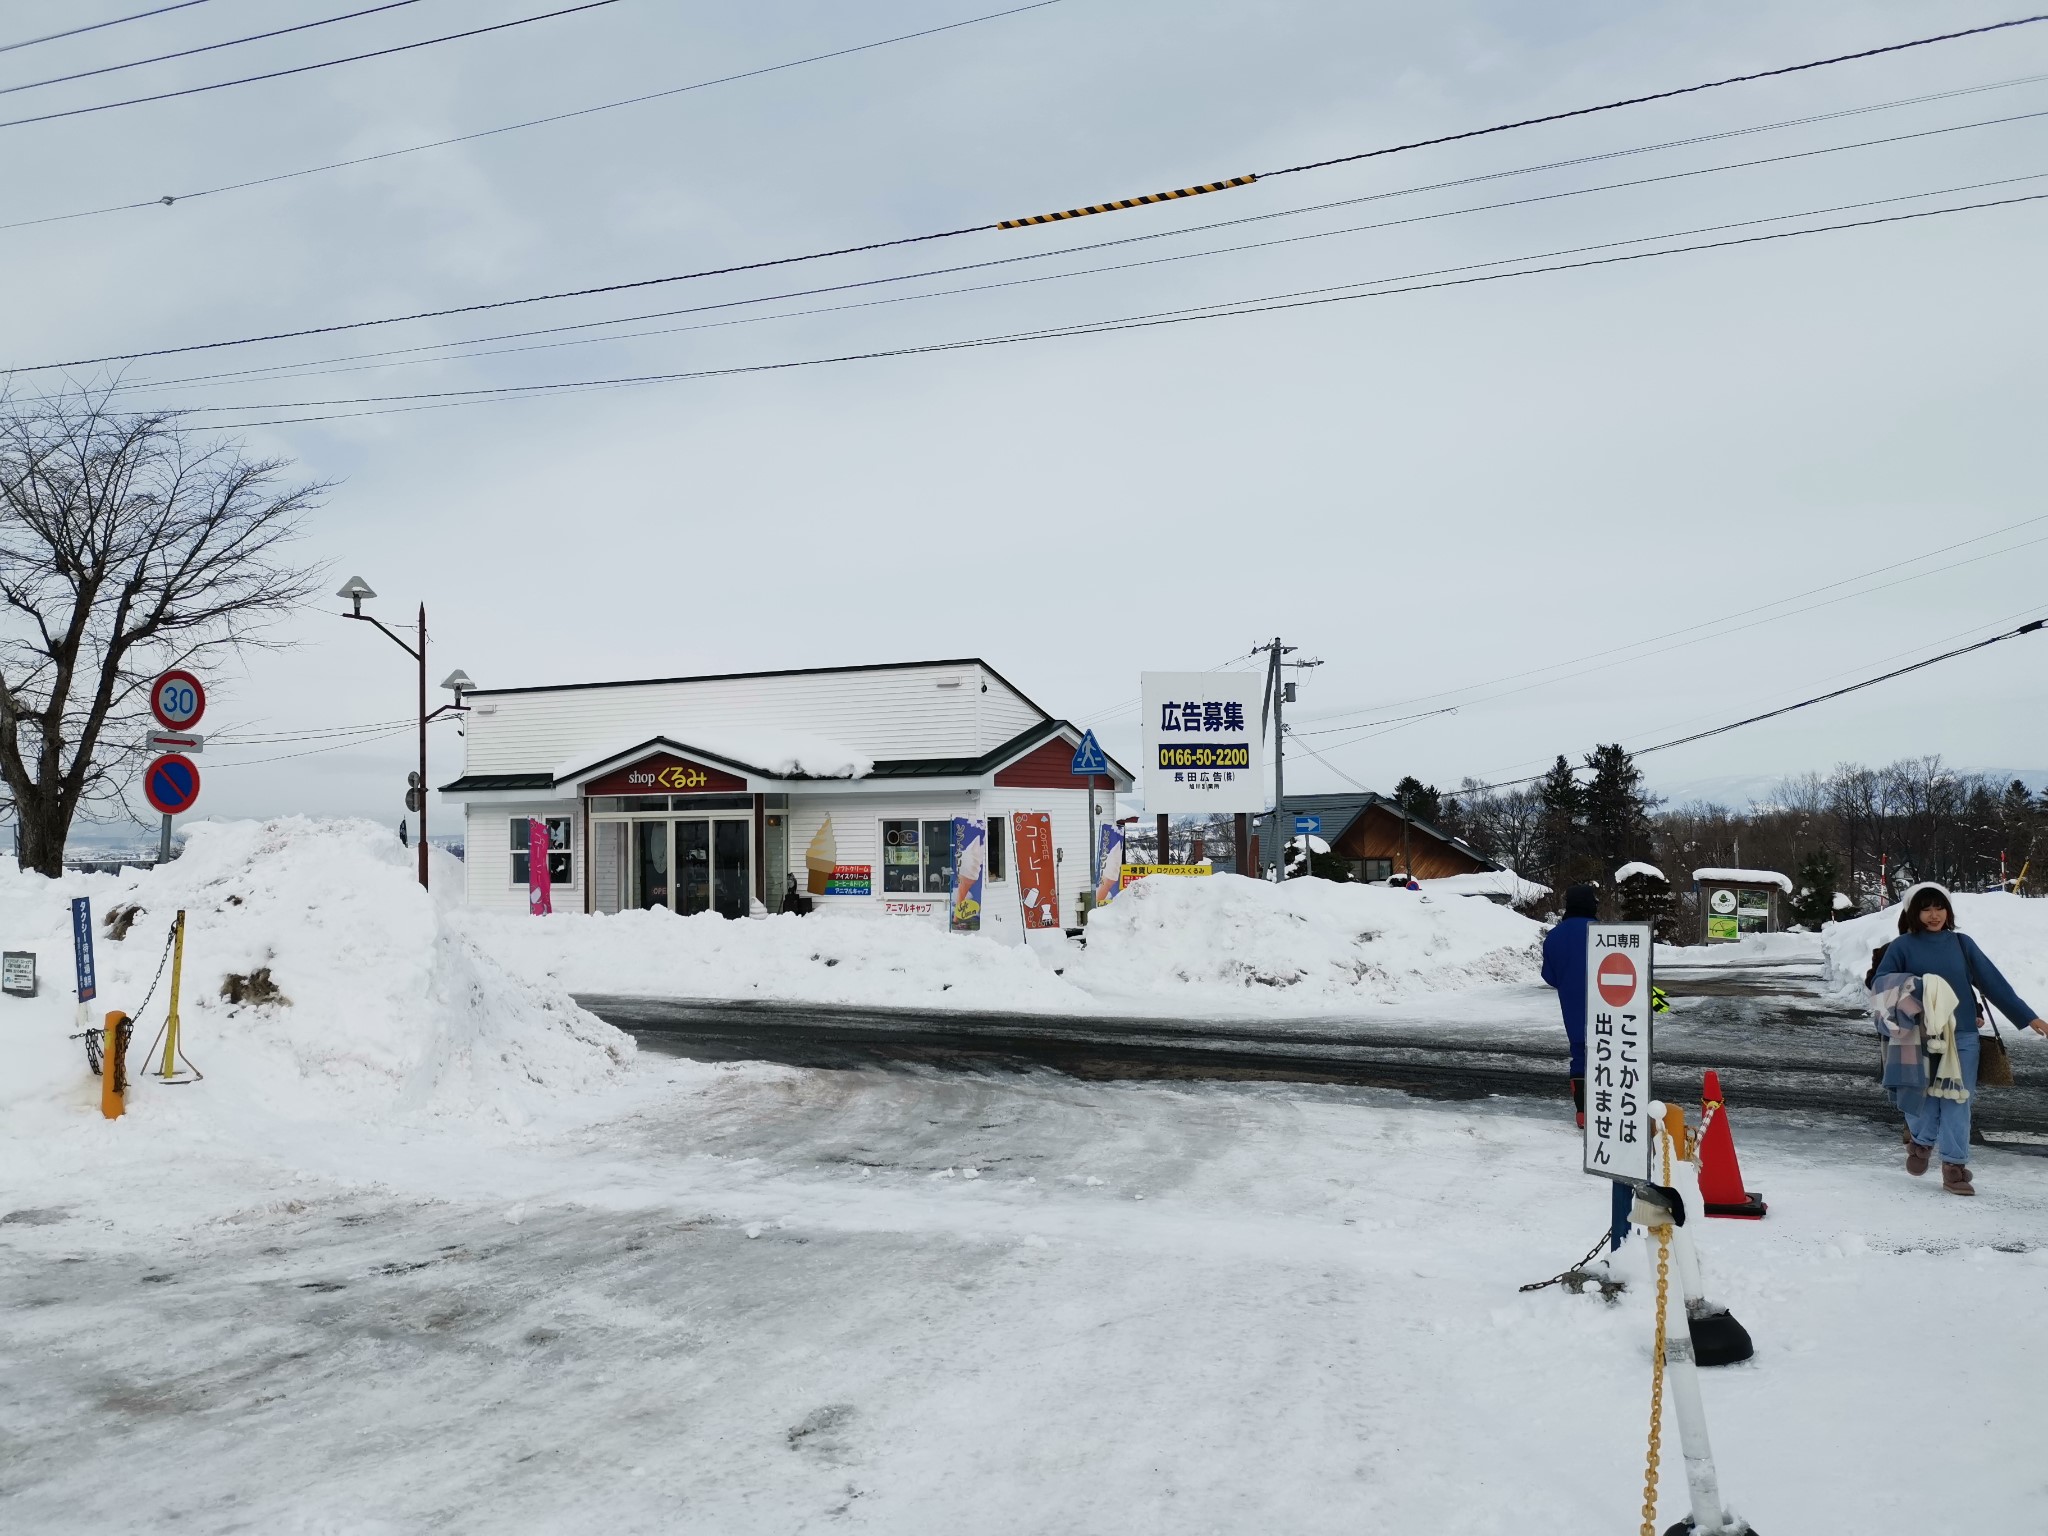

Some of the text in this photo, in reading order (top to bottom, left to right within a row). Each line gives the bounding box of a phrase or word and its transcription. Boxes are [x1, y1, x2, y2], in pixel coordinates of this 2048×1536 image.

[164, 687, 193, 714] 30
[1161, 701, 1244, 732] 広告募集
[1160, 748, 1248, 766] 0166-50-2200
[629, 766, 707, 788] shop くるみ
[1025, 825, 1042, 886] コーヒー
[1039, 827, 1050, 861] COFFEE
[835, 865, 869, 873] ソフトクリーム
[885, 903, 932, 913] アニマルキャップ
[1595, 933, 1640, 949] 入口専用
[1593, 1012, 1615, 1166] 出られません
[1619, 1013, 1640, 1144] ここからは
